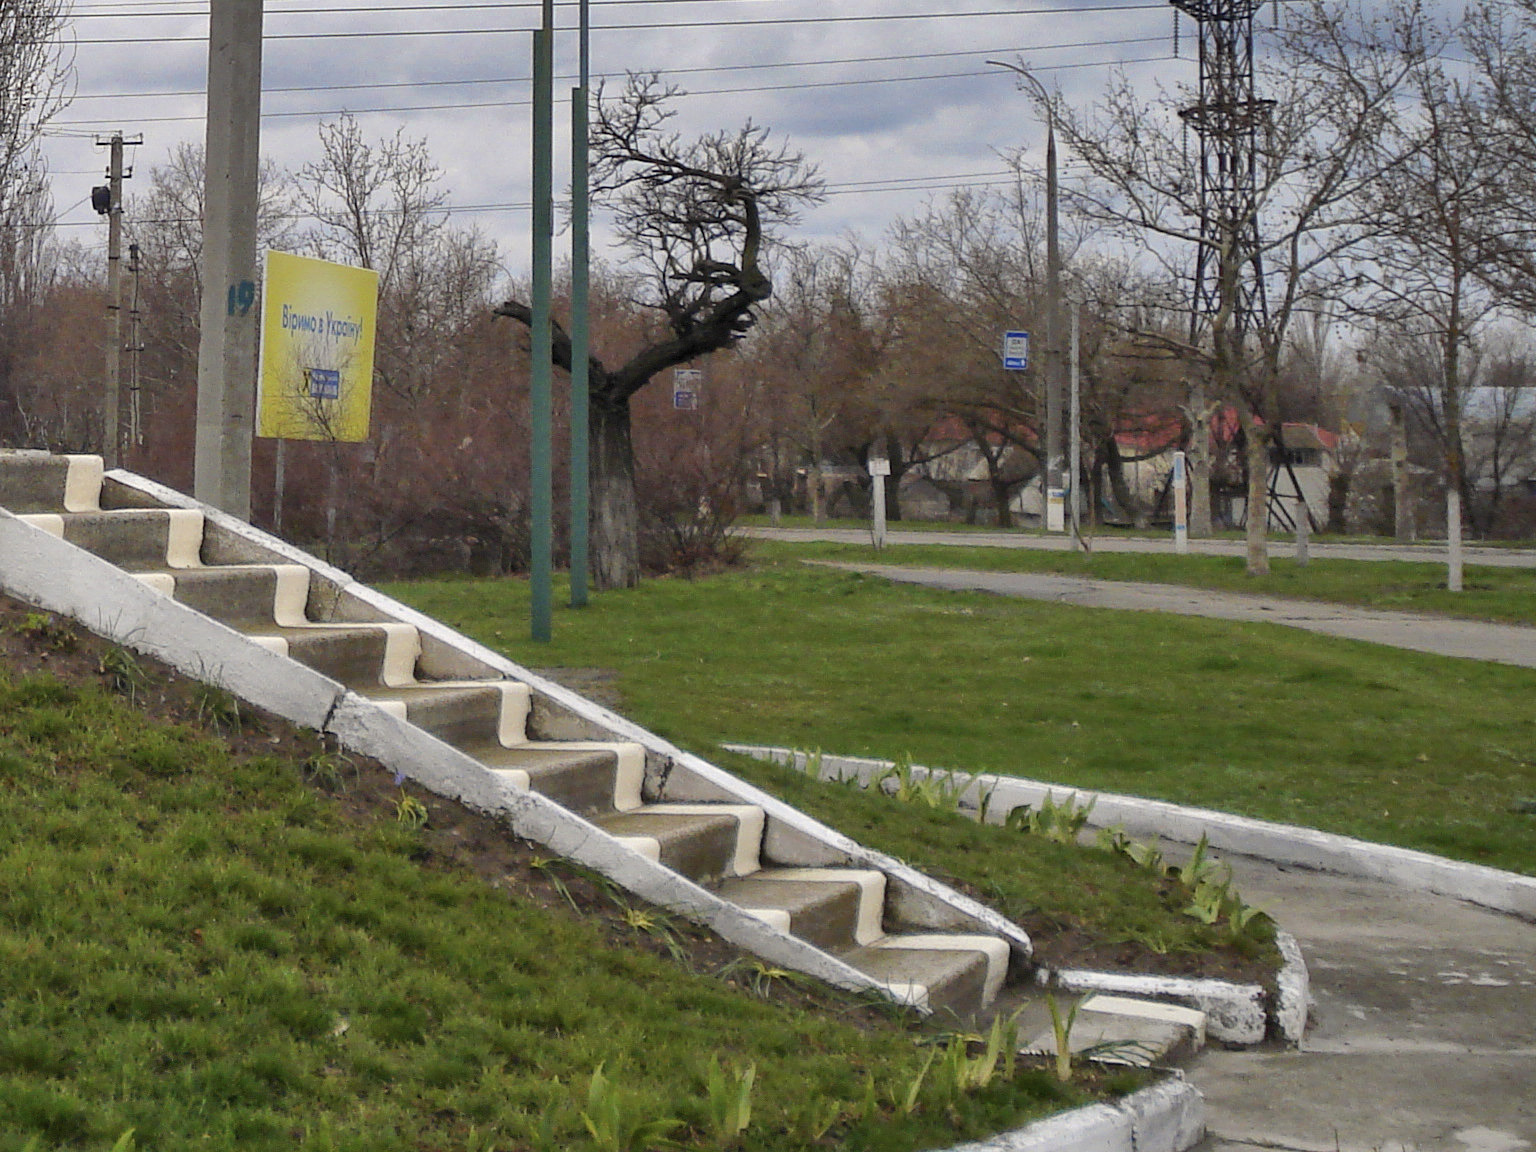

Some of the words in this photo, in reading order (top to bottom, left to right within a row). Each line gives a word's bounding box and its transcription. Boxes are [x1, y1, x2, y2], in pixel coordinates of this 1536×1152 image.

[227, 279, 254, 317] 19
[282, 303, 316, 338] Віримо
[318, 317, 324, 334] в
[325, 310, 363, 347] Україну!
